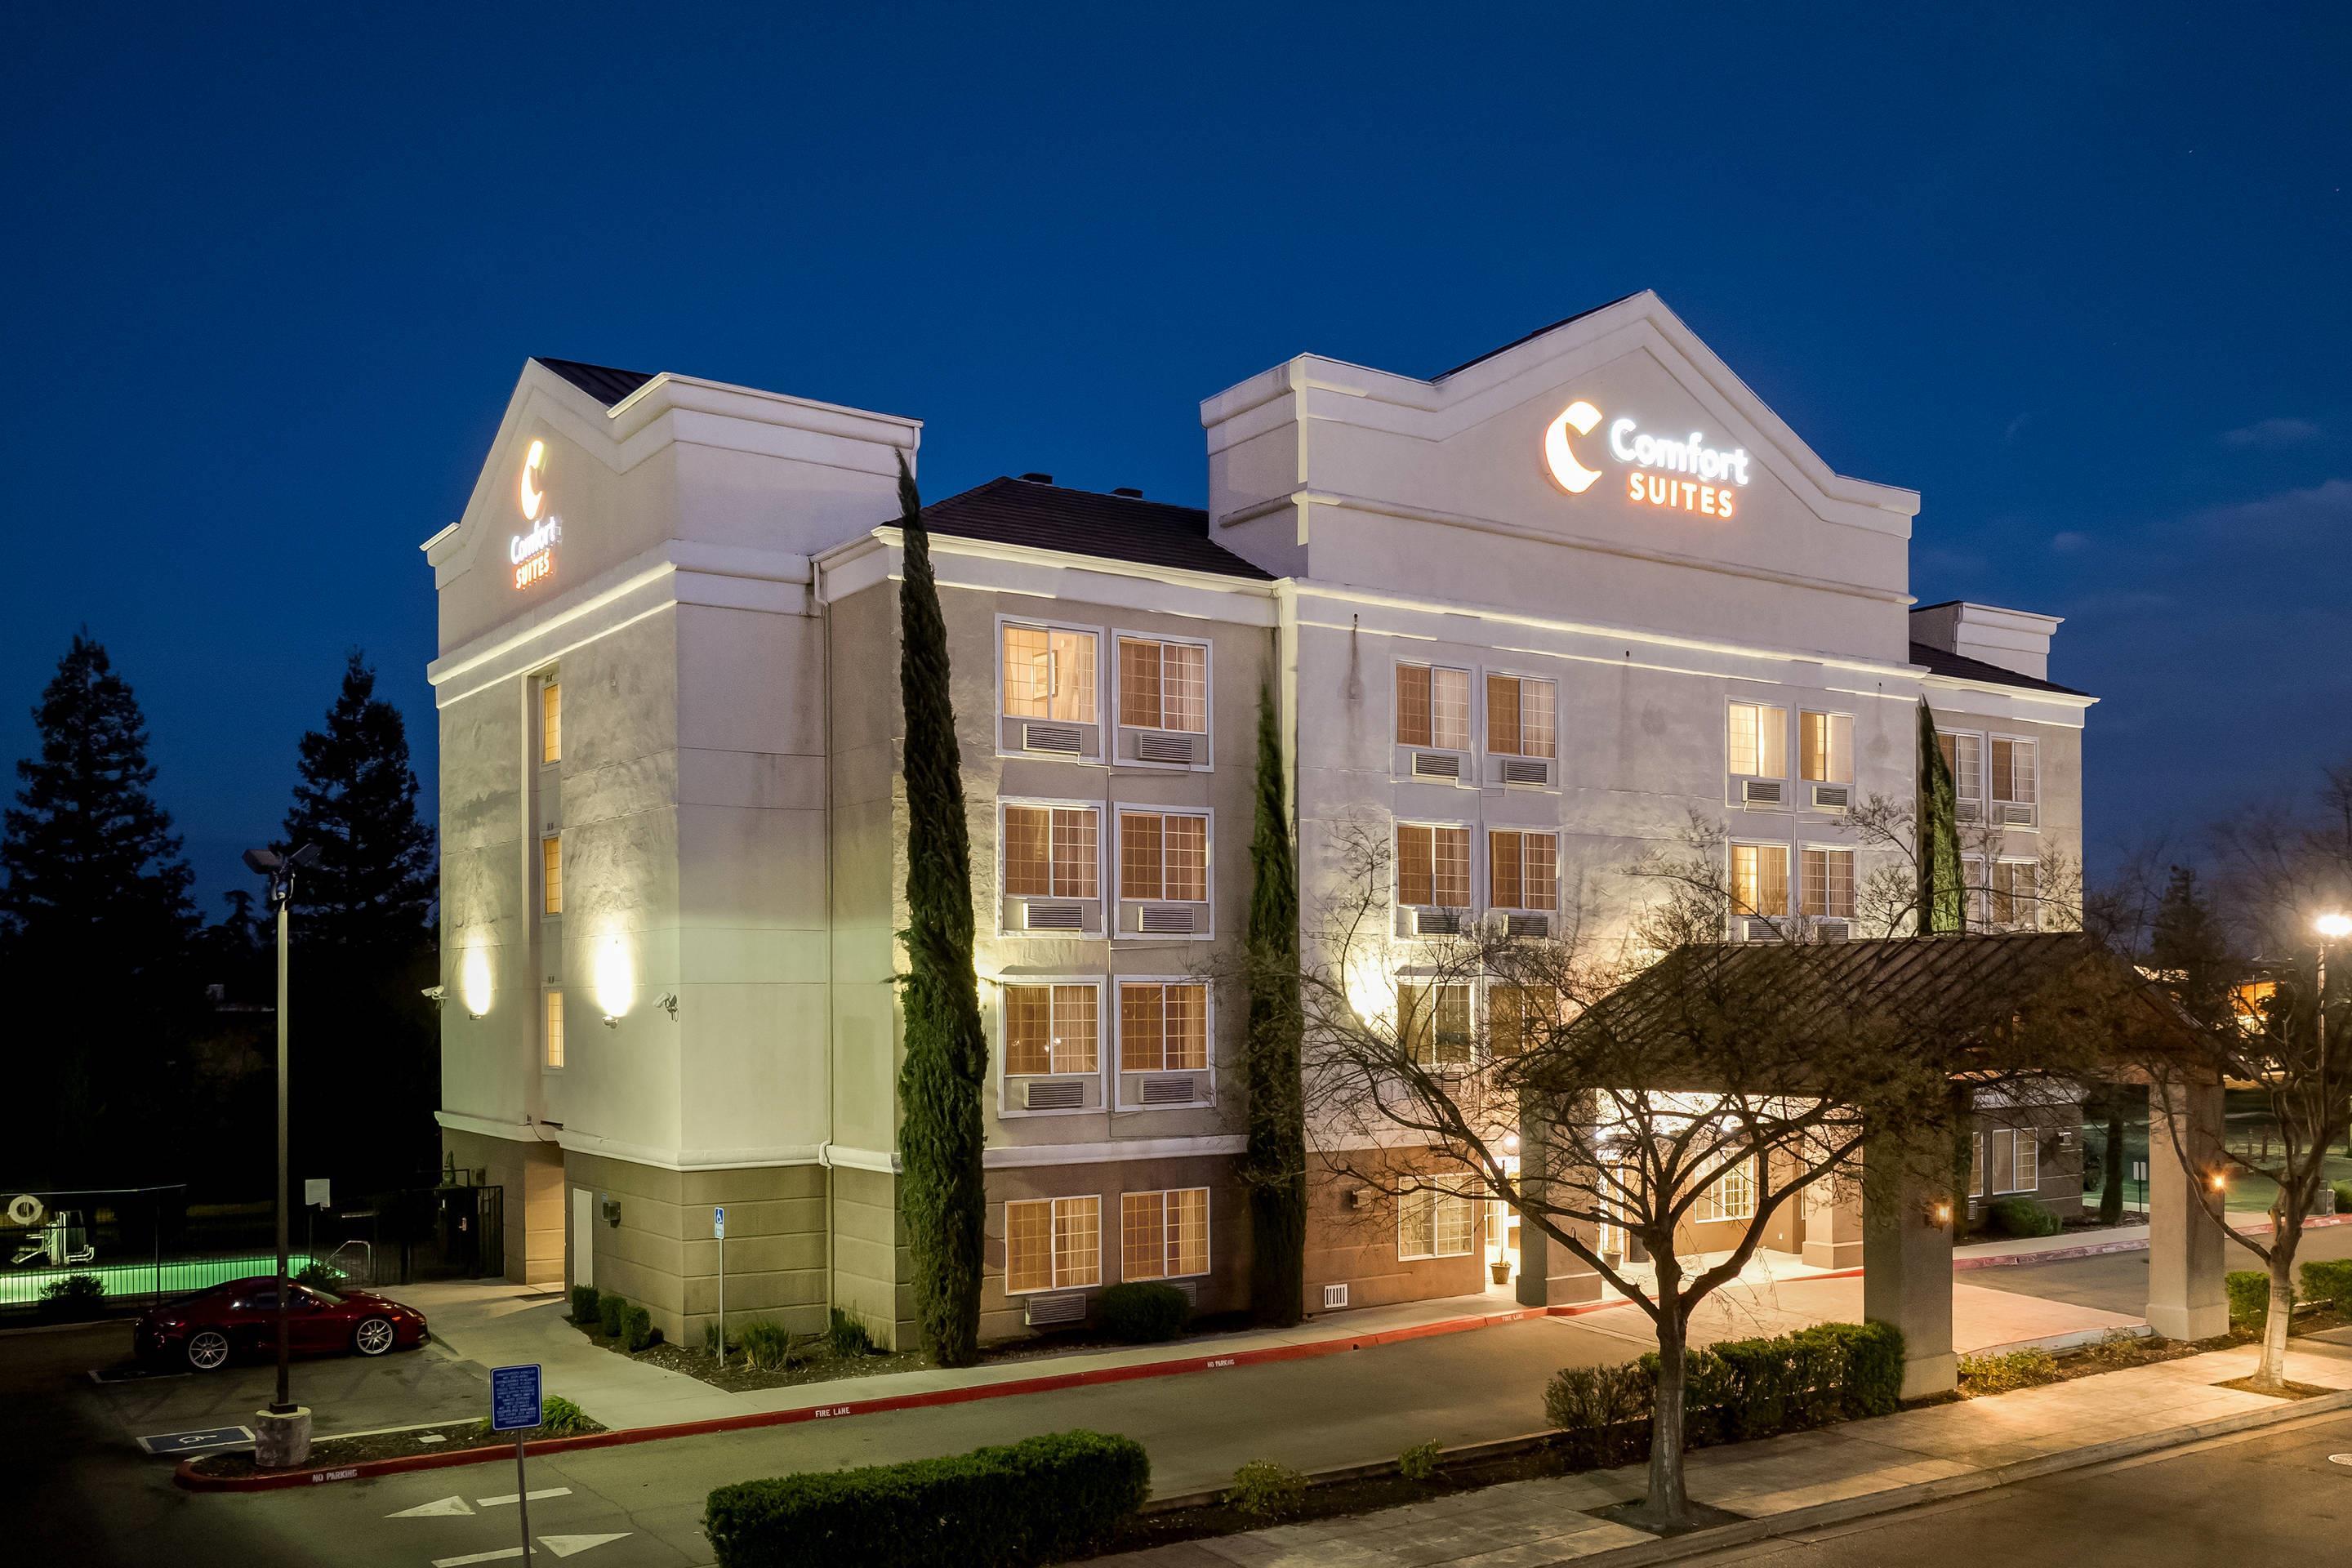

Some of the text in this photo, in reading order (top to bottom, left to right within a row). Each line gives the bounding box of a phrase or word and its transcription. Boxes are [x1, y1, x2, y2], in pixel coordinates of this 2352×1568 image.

[1610, 418, 1748, 485] Comfort
[1629, 472, 1733, 518] SUITES
[510, 516, 555, 564] Comfort
[515, 552, 550, 589] SUITES
[1215, 1359, 1235, 1367] PARKING
[815, 1406, 850, 1418] FIRE LANE
[312, 1469, 358, 1482] NO PARKING
